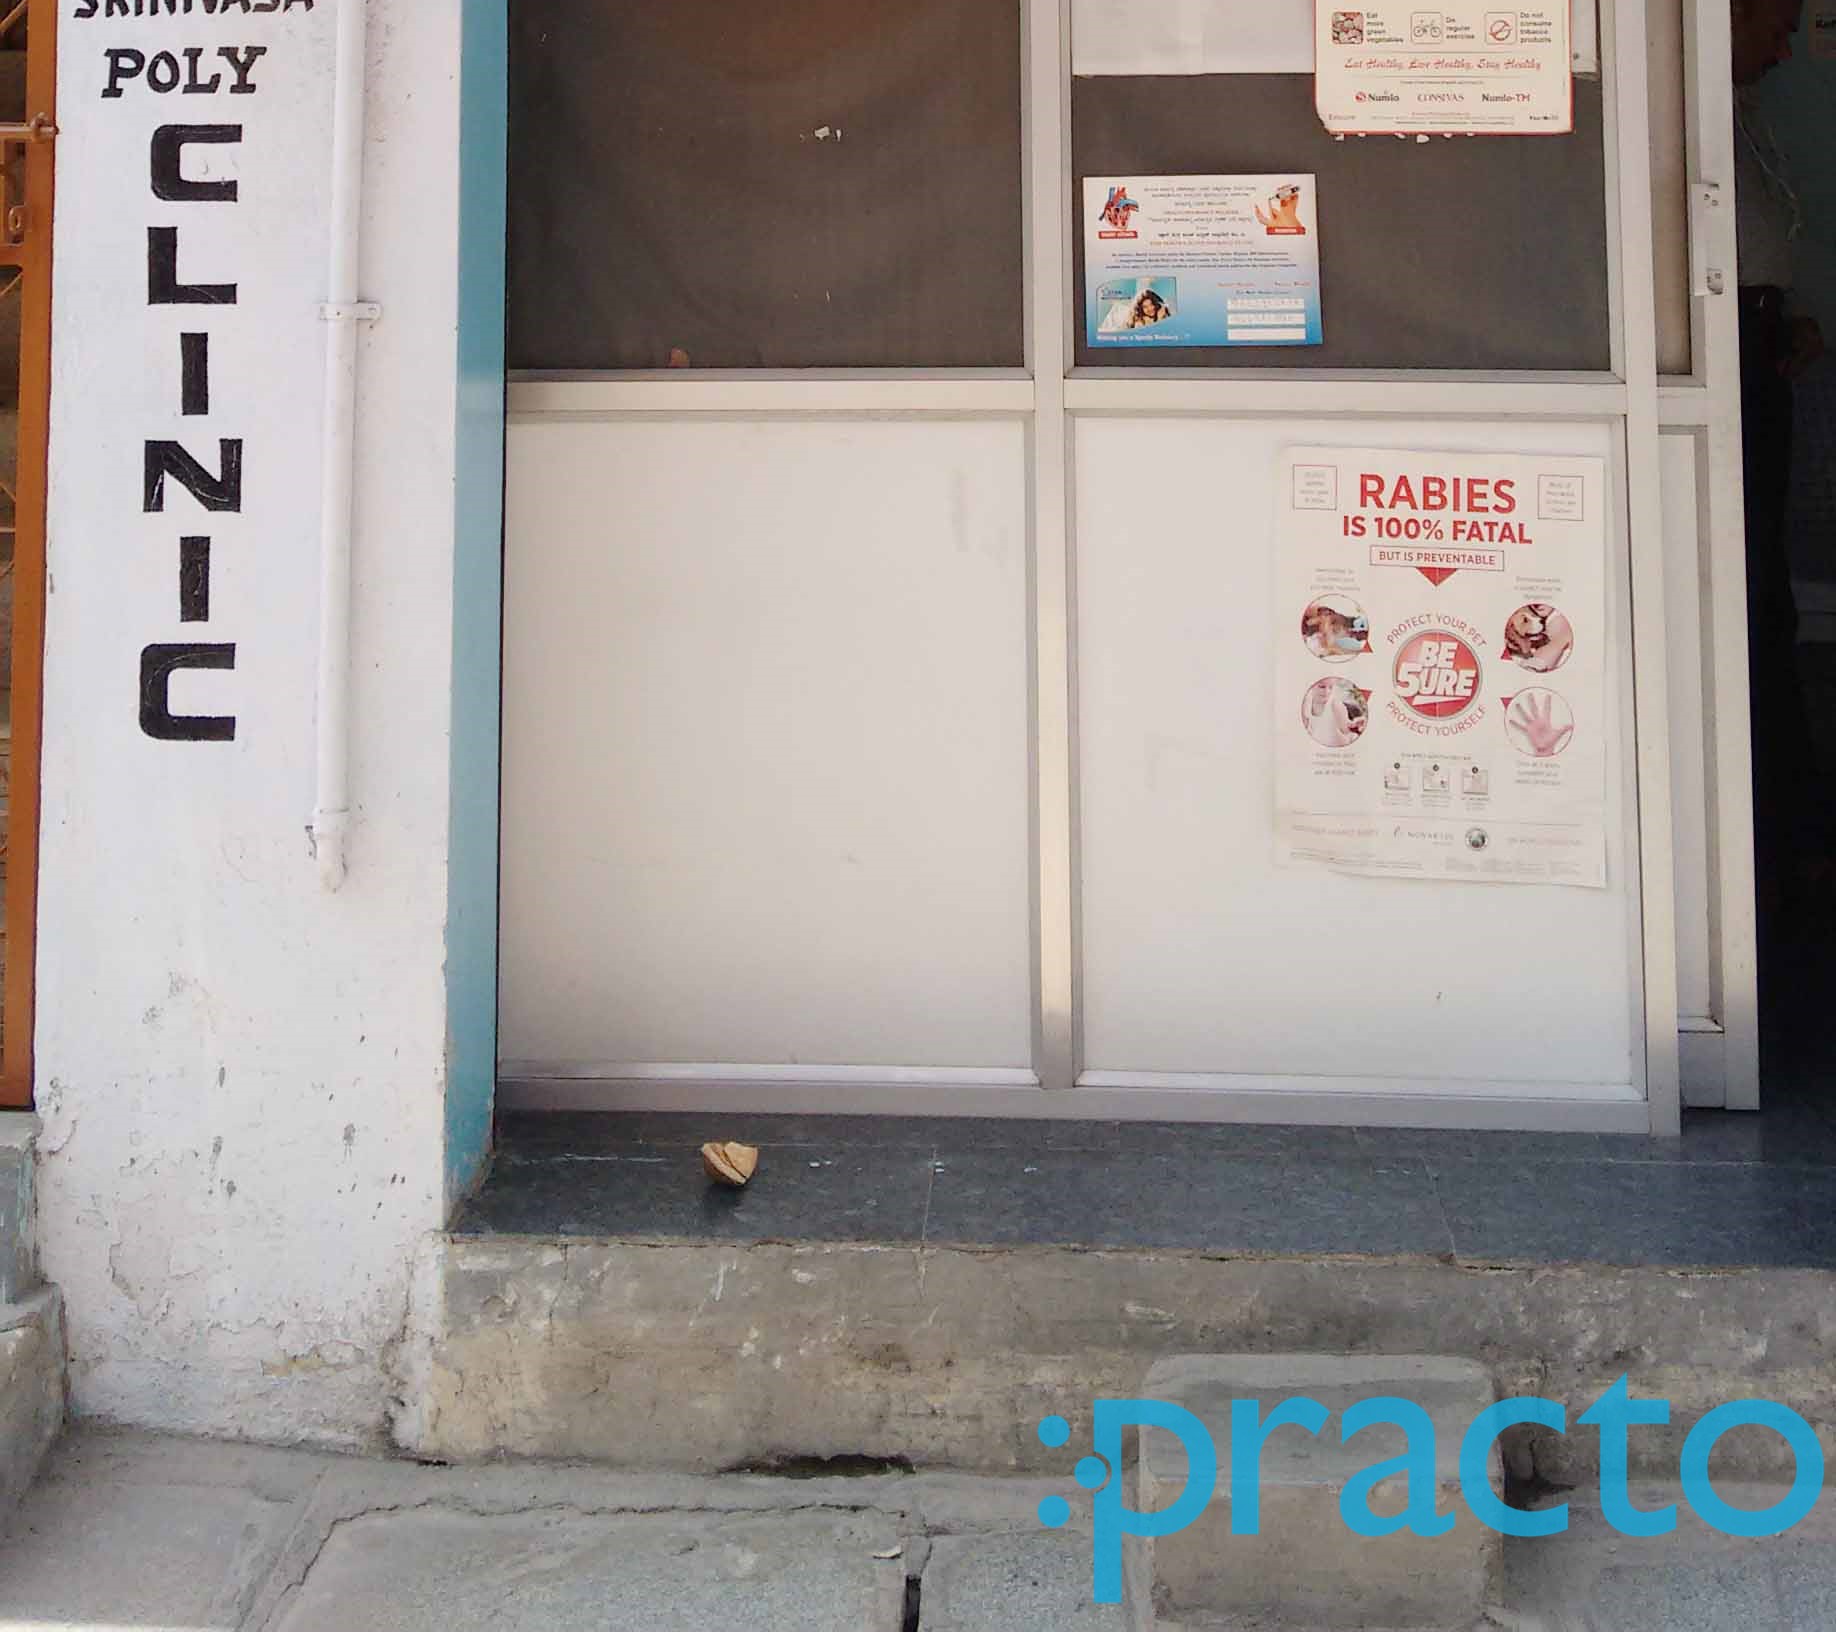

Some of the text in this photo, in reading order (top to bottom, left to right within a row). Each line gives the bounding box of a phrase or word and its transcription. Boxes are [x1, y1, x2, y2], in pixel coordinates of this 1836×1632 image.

[100, 46, 267, 99] POLY
[138, 123, 244, 742] CLINIC
[1359, 473, 1517, 514] RABIES
[1343, 515, 1533, 545] IS 100% FATAL
[1379, 551, 1496, 566] BUT IS PREVENTABLE
[1386, 612, 1488, 648] PROTECT YOUR PET
[1418, 640, 1459, 669] BE
[1396, 662, 1478, 697] SURE
[1386, 701, 1488, 737] PROTECT YOURSELF
